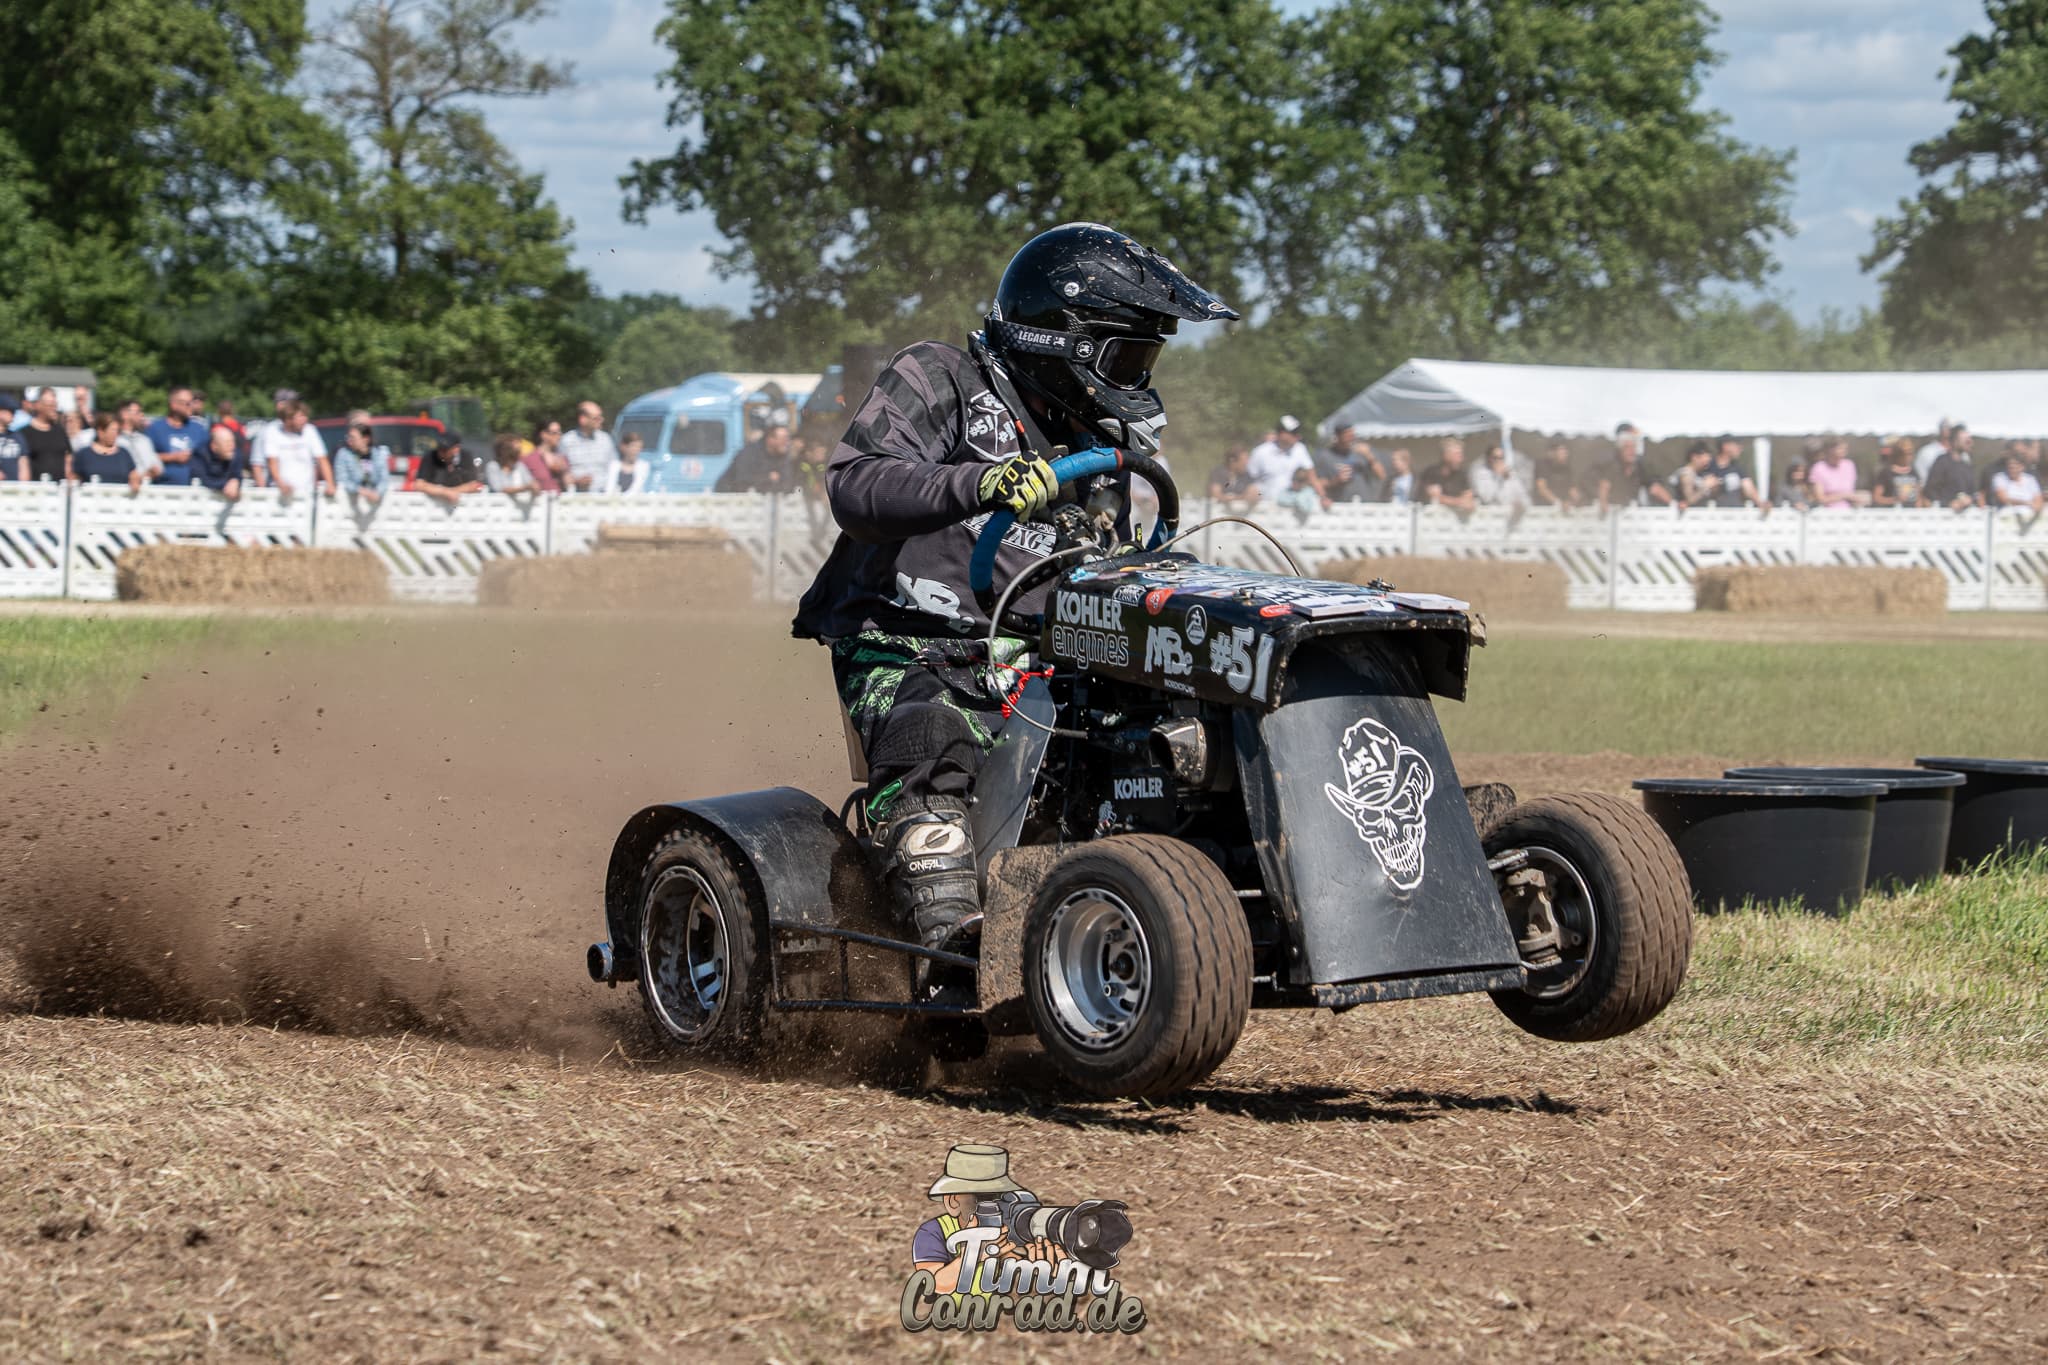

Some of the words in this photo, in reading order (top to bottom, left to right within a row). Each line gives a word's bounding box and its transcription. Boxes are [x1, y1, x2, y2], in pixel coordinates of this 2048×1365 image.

[1018, 330, 1053, 345] LECAGE
[969, 414, 995, 437] #51
[1056, 590, 1125, 632] KOHLER
[1052, 624, 1129, 670] engines
[1209, 626, 1275, 703] #51
[1348, 740, 1389, 778] #51
[1113, 777, 1164, 799] KOHLER
